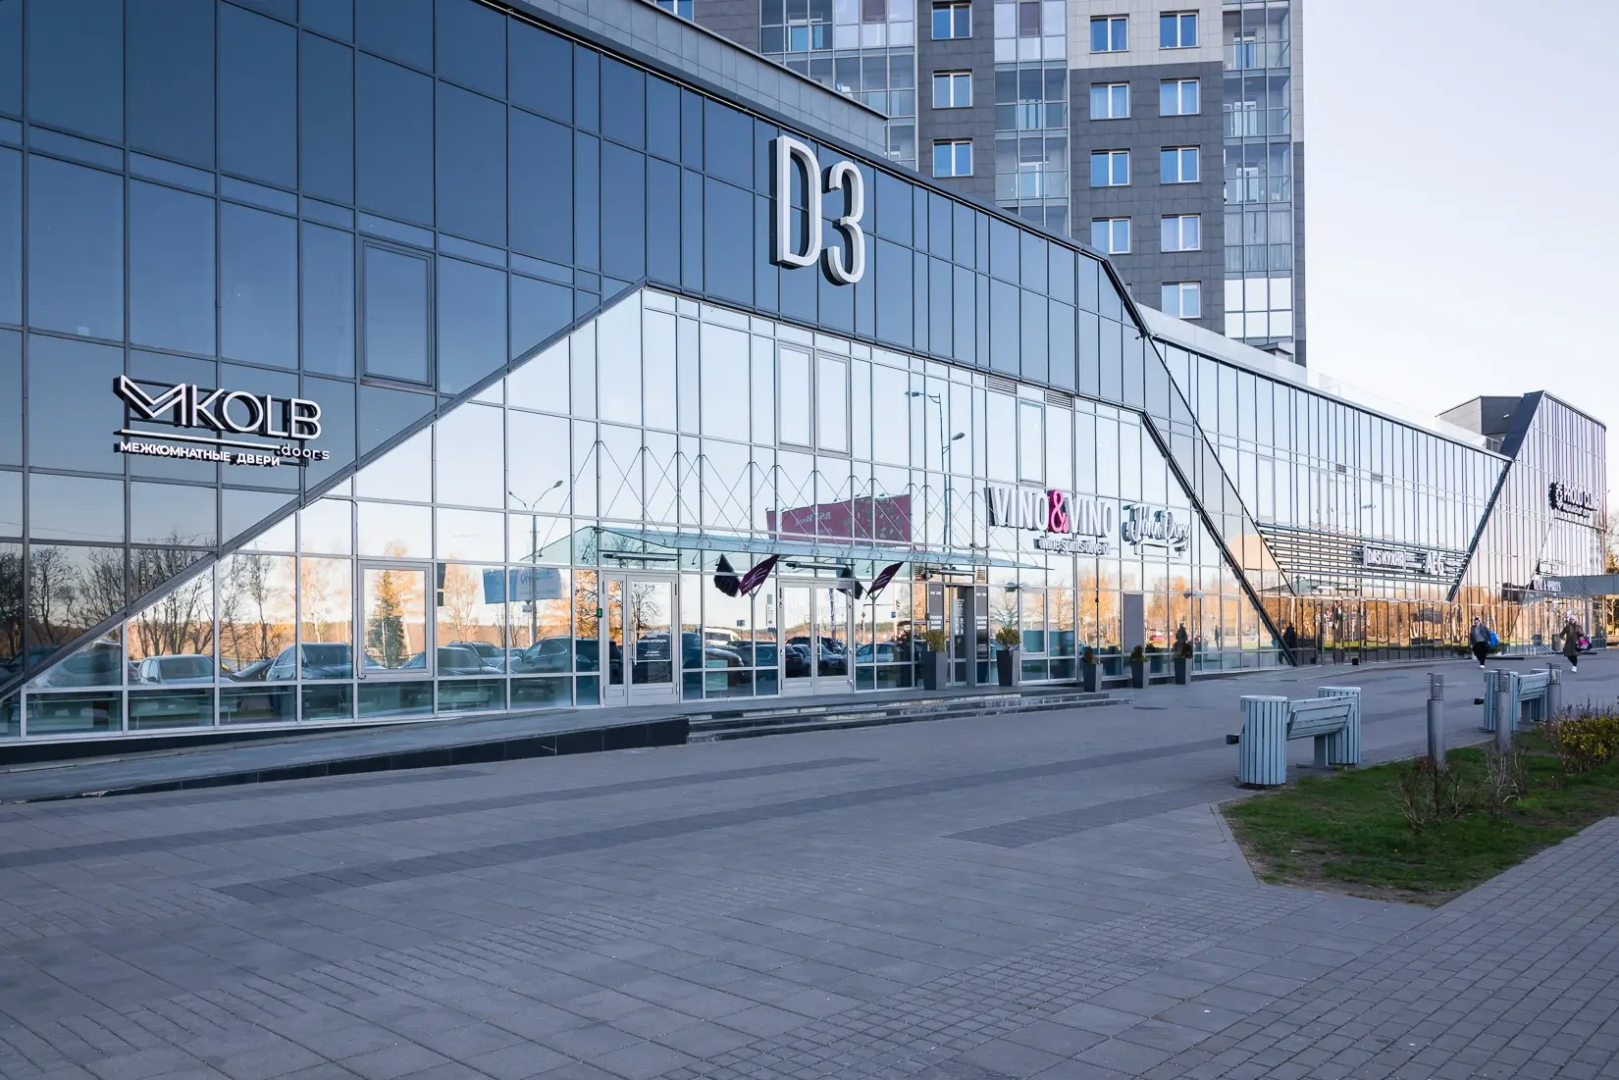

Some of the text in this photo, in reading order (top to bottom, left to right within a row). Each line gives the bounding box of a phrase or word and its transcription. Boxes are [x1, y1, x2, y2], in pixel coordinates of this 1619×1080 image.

[775, 135, 866, 284] D3
[118, 374, 322, 440] MKOLB
[119, 441, 281, 468] МЕЖКОМНАТНЫЕ ДВЕРИ
[280, 443, 331, 460] doors
